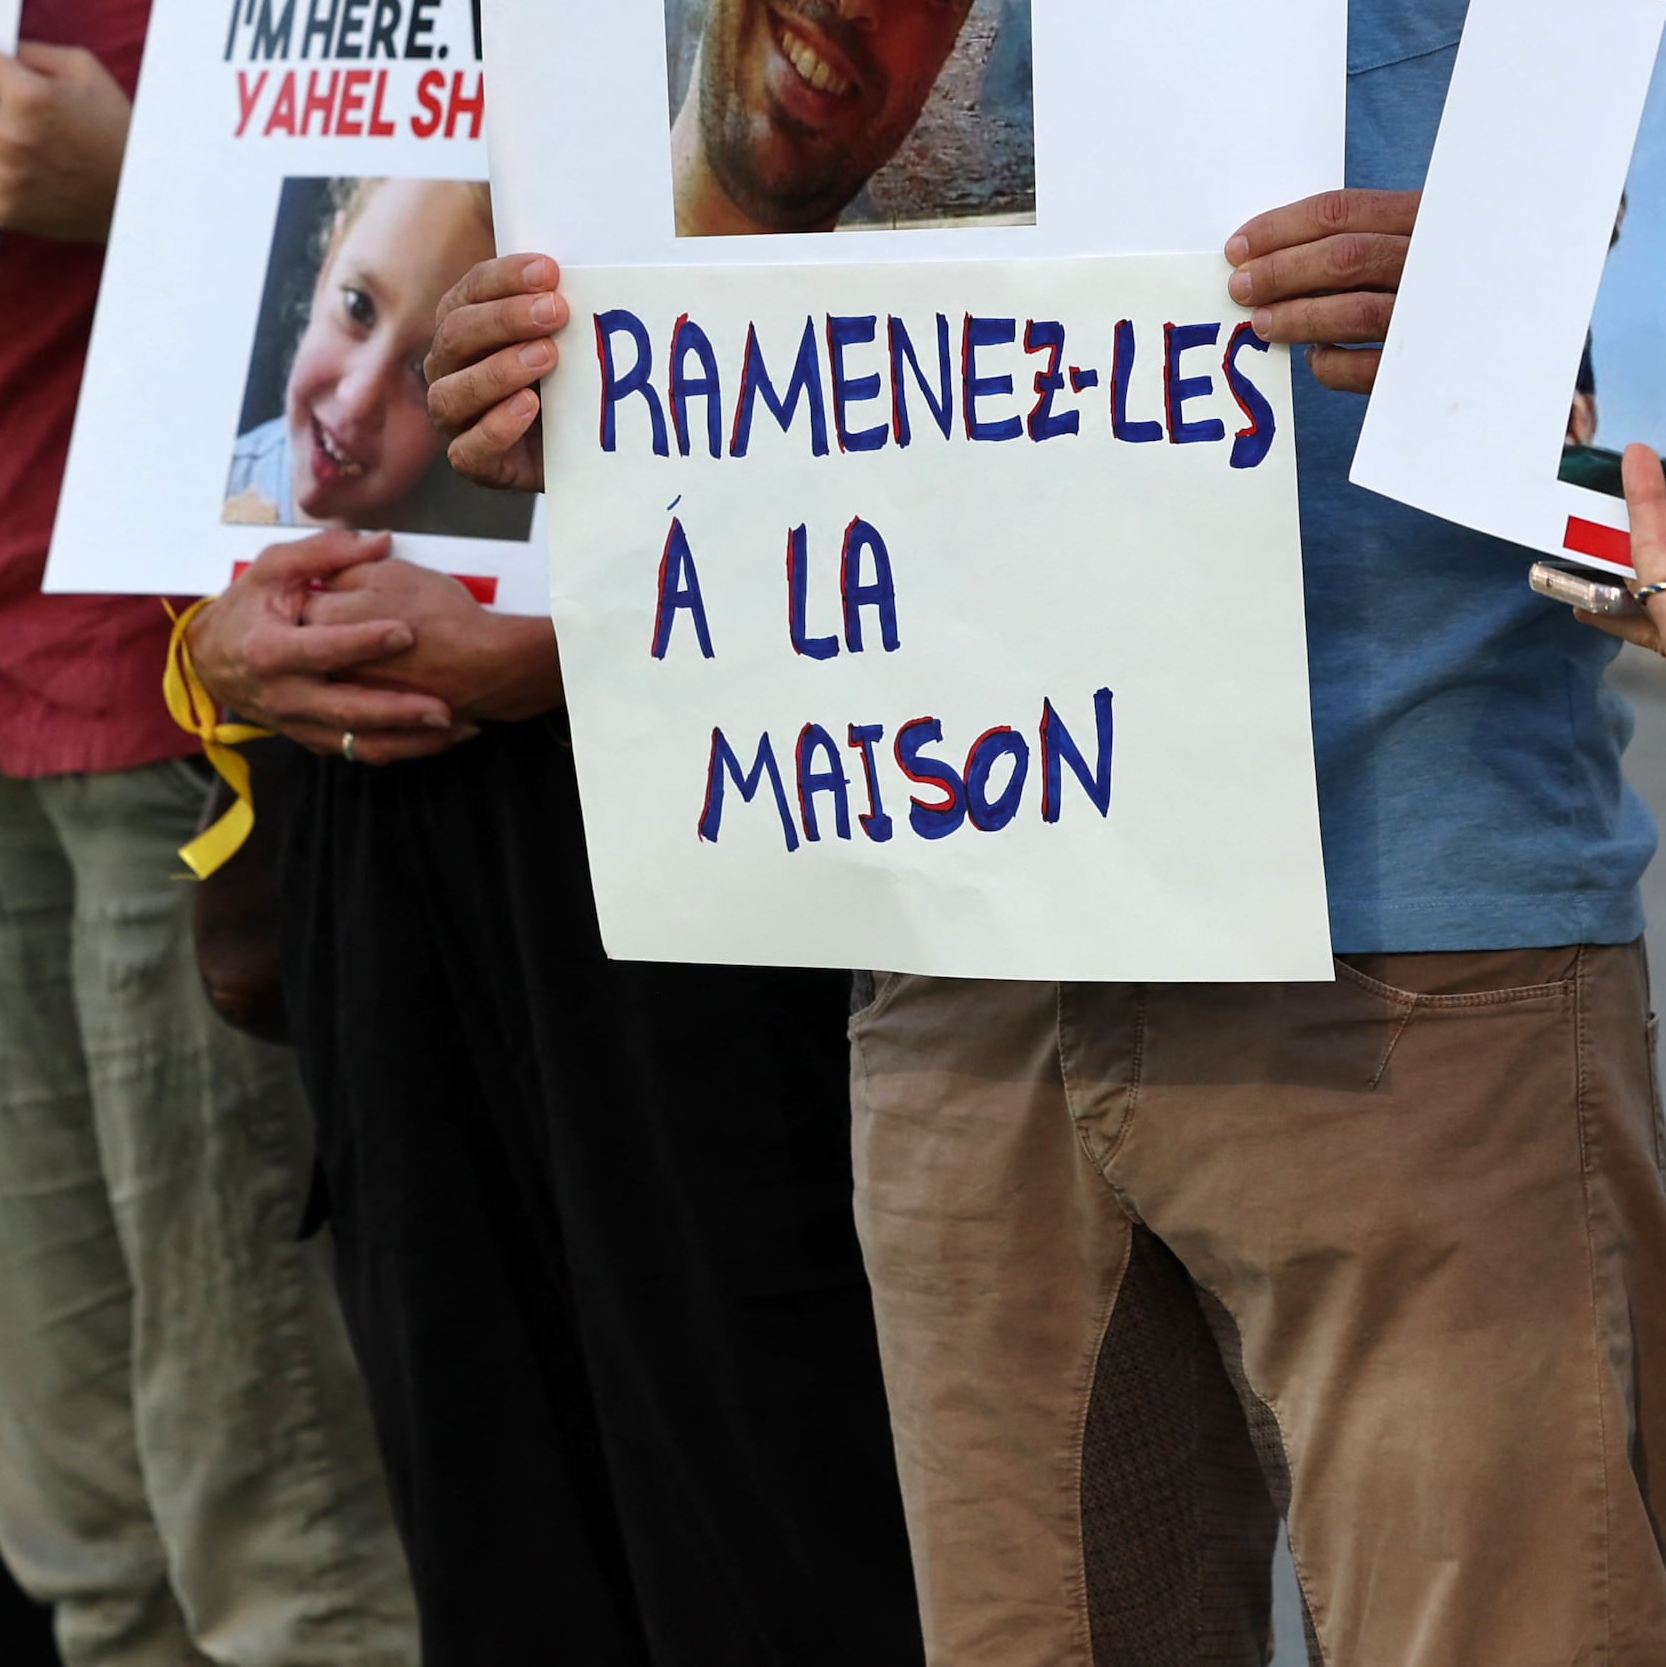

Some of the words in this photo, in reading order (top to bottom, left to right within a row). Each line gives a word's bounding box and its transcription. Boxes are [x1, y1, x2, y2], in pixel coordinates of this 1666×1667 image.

[233, 68, 395, 138] YAHEL
[593, 308, 1276, 469] RAMENEZ-LES
[786, 515, 901, 662] LA
[697, 686, 1114, 853] MAISON
